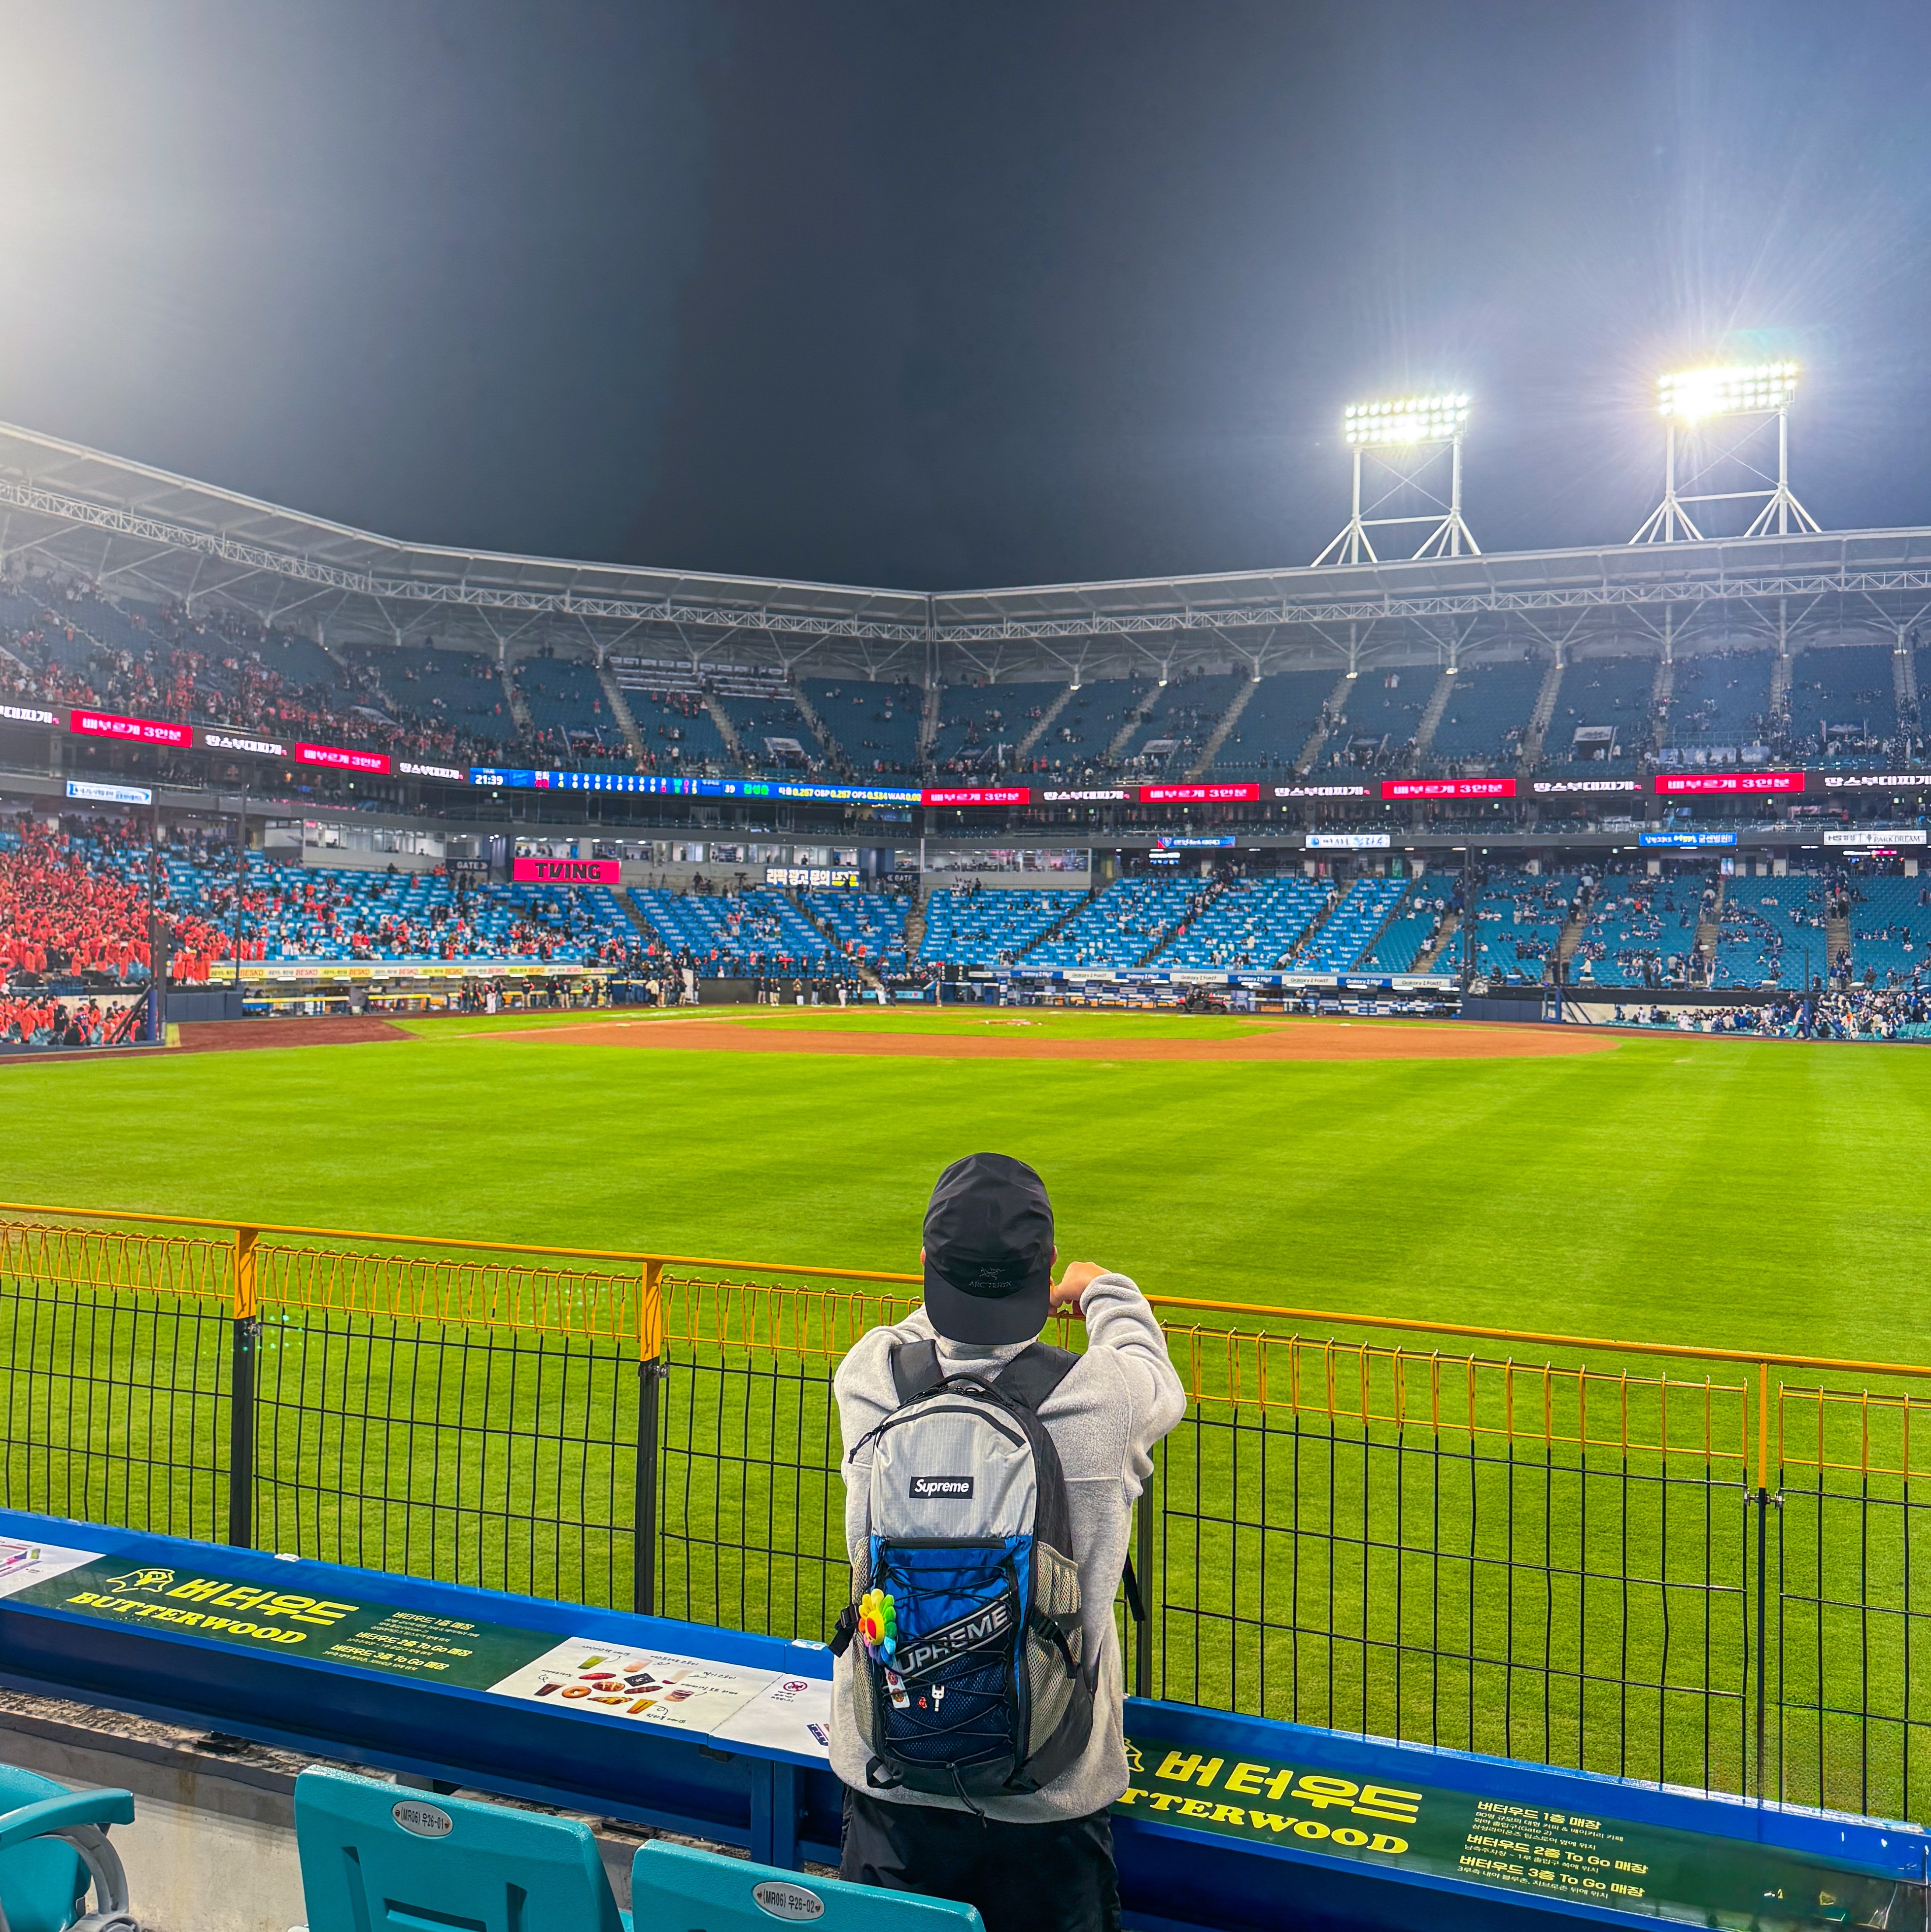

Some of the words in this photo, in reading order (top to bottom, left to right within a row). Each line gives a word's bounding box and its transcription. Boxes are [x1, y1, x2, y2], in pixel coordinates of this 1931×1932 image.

[82, 717, 140, 735] 배부르게
[144, 726, 181, 741] 3인분
[205, 734, 282, 755] 땅스부대찌개
[304, 749, 349, 764] 배부르게
[351, 756, 381, 769] 3인분
[475, 774, 504, 786] 21:39
[725, 784, 735, 793] 39
[1393, 785, 1455, 795] 배부르게
[1460, 784, 1502, 794] 3인분
[1533, 781, 1634, 793] 땅스부대찌개
[1667, 779, 1736, 790] 배부르게
[1742, 778, 1790, 788] 3인분
[851, 791, 867, 799] OPS
[931, 793, 981, 801] 배부르게
[985, 793, 1019, 801] 3인분
[1043, 791, 1124, 801] 땅스부대찌개
[1150, 790, 1205, 798] 배부르게
[1209, 789, 1247, 797] 3인분
[1274, 786, 1364, 797] 땅스부대찌개
[457, 861, 479, 869] GATE
[535, 863, 601, 880] TVING
[766, 868, 788, 885] 라팍
[789, 869, 808, 886] 광고
[810, 870, 830, 886] 문의
[914, 1479, 969, 1496] Supreme
[165, 1578, 360, 1625] 버터우드
[66, 1591, 307, 1644] BUTTERWOOD
[392, 1612, 436, 1623] 버터우드
[450, 1622, 475, 1630] 매장
[355, 1631, 400, 1644] 버터우드
[397, 1638, 418, 1647] 2층
[430, 1645, 448, 1653] Go
[447, 1647, 473, 1657] 매장
[896, 1604, 1008, 1674] UPREME
[330, 1644, 376, 1656] 버터우드
[373, 1652, 395, 1660] 3층
[423, 1660, 449, 1670] 매장
[1155, 1751, 1423, 1824] 버터우드
[401, 1807, 420, 1825] (MR06)
[422, 1813, 444, 1830] 우26-01
[1116, 1787, 1409, 1853] TTERWOOD
[1478, 1801, 1539, 1819] 버터우드
[1544, 1812, 1565, 1824] 1층
[1569, 1816, 1602, 1830] 매장
[1467, 1833, 1530, 1853] 버터우드
[1534, 1846, 1561, 1859] 2층
[1565, 1851, 1584, 1862] To
[1587, 1855, 1611, 1867] Go
[1615, 1860, 1649, 1874] 매장
[1459, 1855, 1524, 1875] 버터우드
[1528, 1867, 1555, 1882] 3층
[1559, 1872, 1579, 1885] To
[1583, 1878, 1606, 1890] Go
[1611, 1883, 1645, 1898] 매장
[763, 1888, 786, 1908] (MR06)
[789, 1895, 814, 1913] 우26-02
